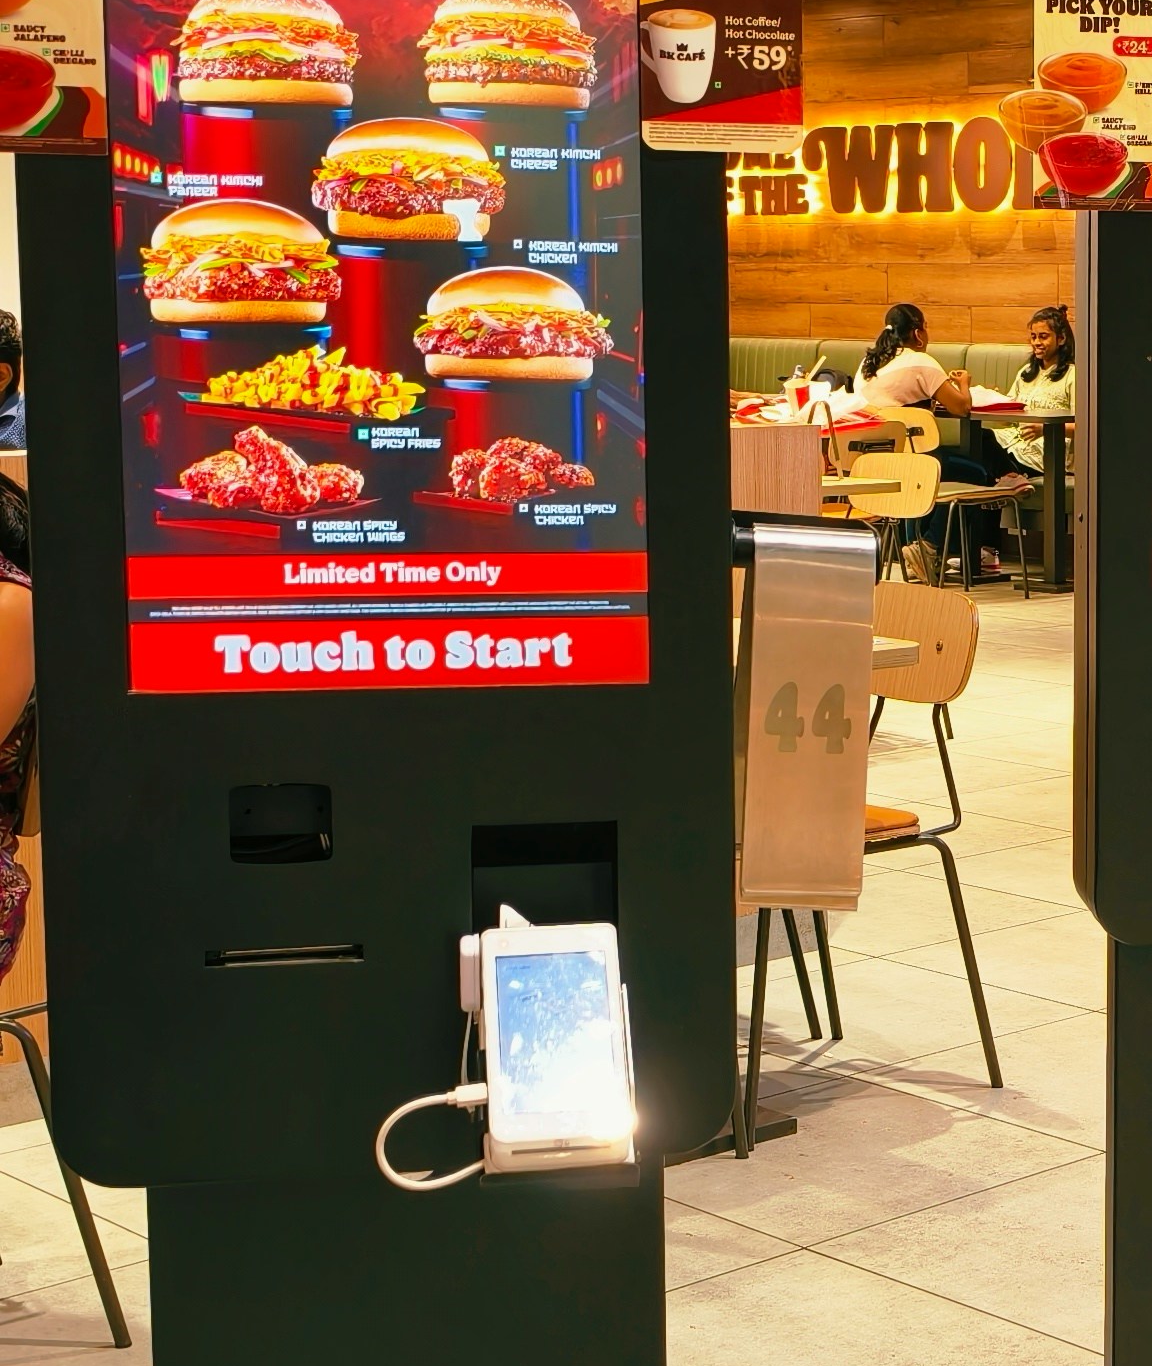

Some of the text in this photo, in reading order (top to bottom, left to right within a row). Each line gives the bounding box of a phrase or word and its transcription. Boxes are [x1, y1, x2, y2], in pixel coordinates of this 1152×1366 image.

[724, 16, 781, 28] Hot Coffee/
[1079, 16, 1121, 34] DIP!
[725, 29, 795, 41] Hot Chocolate
[659, 48, 706, 61] BK CAFÉ
[739, 174, 809, 215] THE
[283, 560, 501, 587] Limited Time Only
[214, 630, 573, 674] Touch to Start
[764, 681, 852, 754] 44
